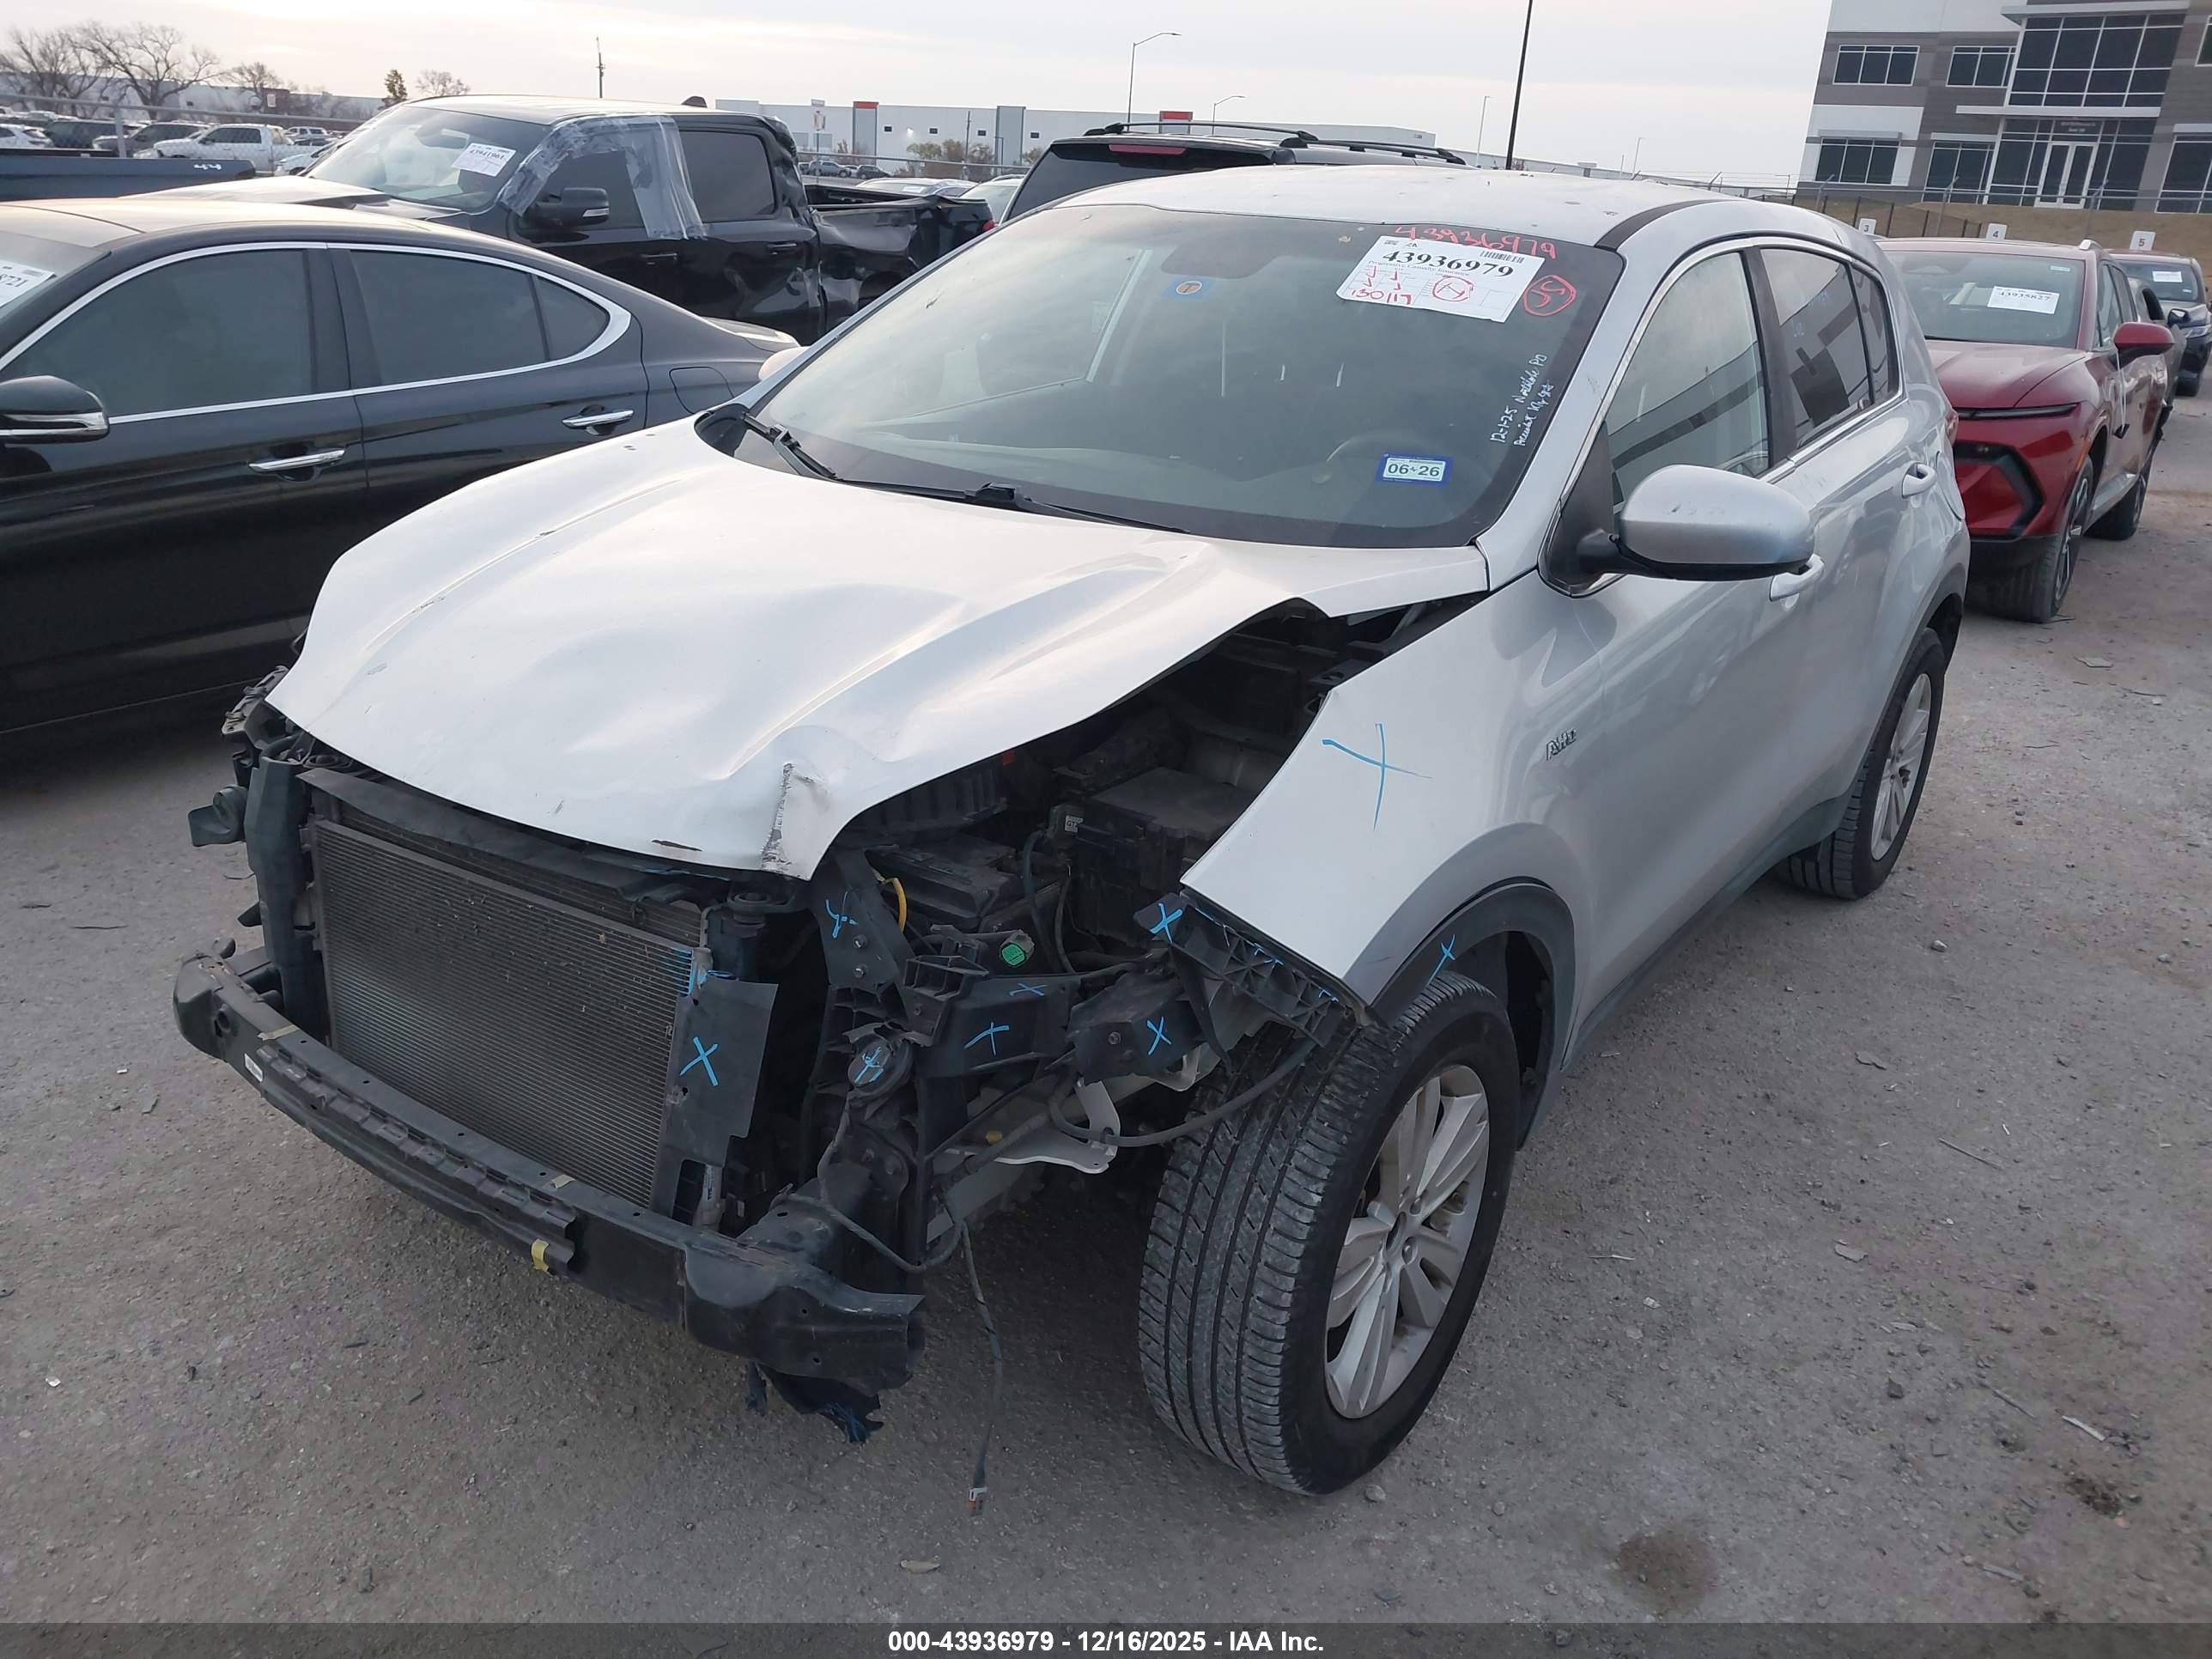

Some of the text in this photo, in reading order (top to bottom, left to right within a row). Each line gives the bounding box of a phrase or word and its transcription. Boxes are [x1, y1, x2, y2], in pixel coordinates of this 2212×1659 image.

[1863, 224, 1869, 233] 3
[2138, 238, 2146, 247] 5
[1382, 251, 1514, 277] 43936979
[1388, 463, 1441, 477] 06 26
